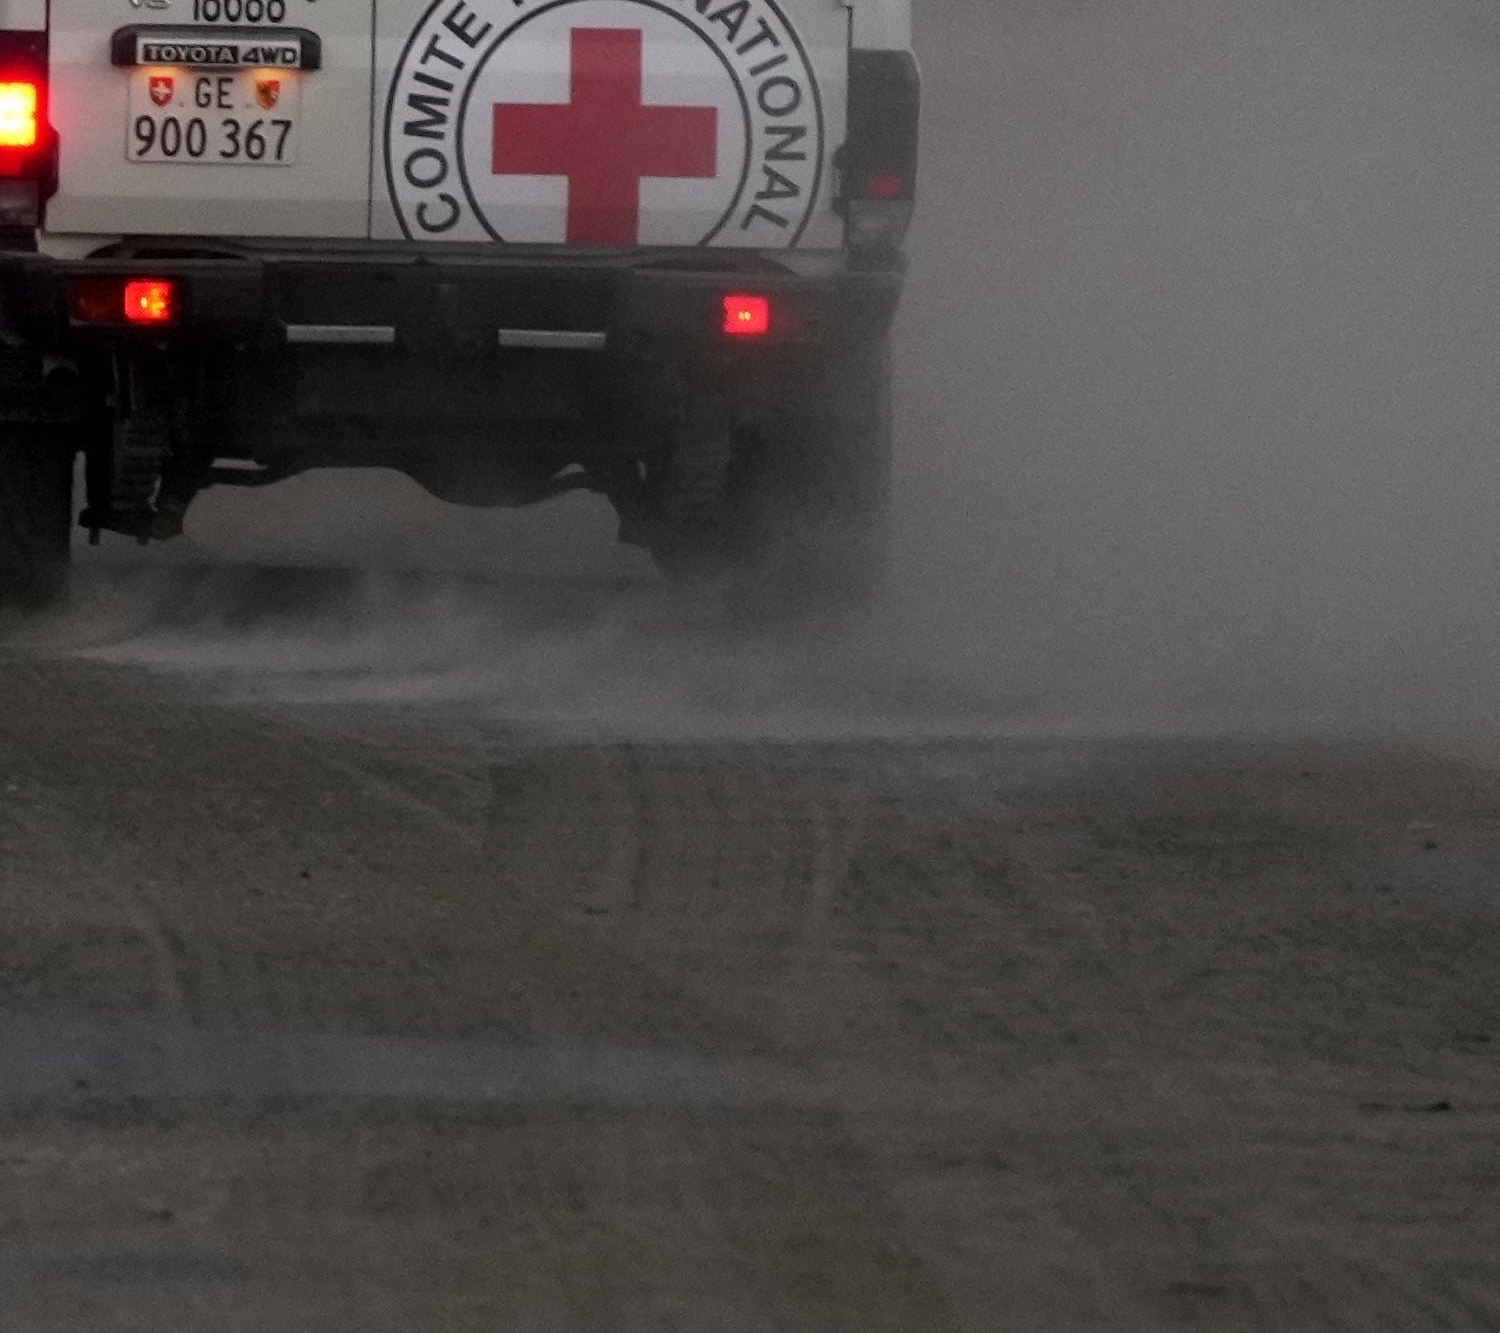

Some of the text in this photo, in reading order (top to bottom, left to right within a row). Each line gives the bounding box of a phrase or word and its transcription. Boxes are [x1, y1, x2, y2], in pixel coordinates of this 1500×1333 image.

[147, 46, 298, 64] TOYOTA 4WD
[195, 76, 234, 109] GE
[403, 0, 493, 234] COMITE
[134, 114, 293, 161] 900 367
